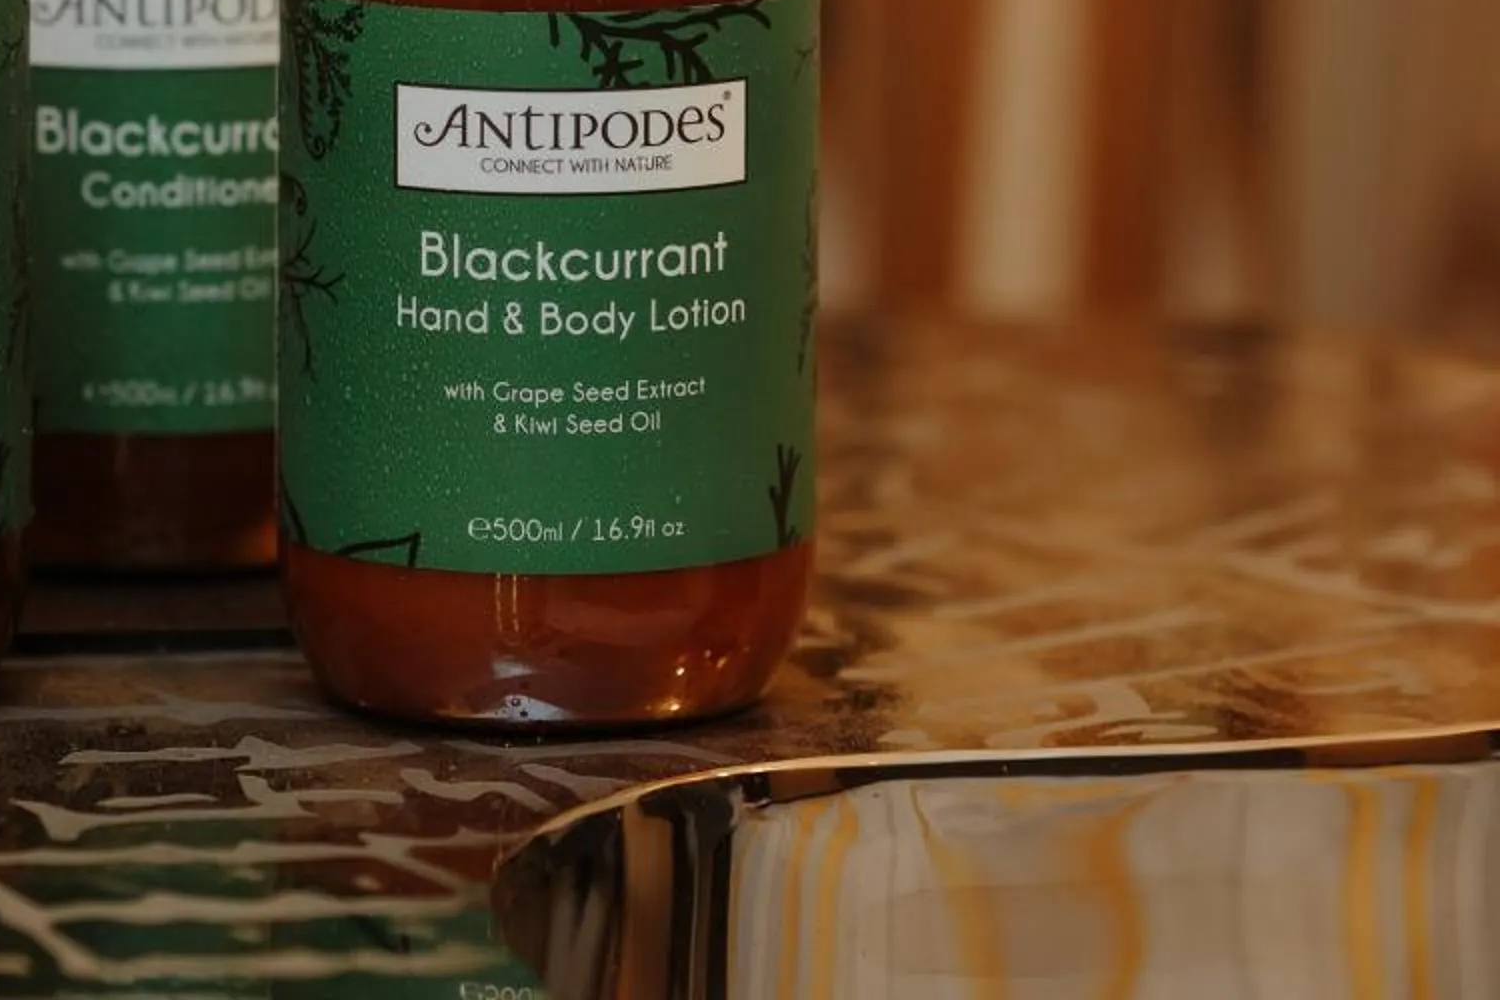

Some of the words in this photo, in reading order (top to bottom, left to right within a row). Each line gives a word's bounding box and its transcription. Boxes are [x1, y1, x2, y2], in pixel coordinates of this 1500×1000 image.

[480, 157, 564, 175] CONNECT
[569, 158, 610, 173] WITH
[614, 154, 673, 172] NATURE
[420, 230, 728, 282] Blackcurrant
[397, 294, 489, 334] Hand
[503, 301, 524, 335] &
[540, 301, 636, 341] Body
[650, 298, 745, 332] Lotion
[443, 380, 485, 401] with
[492, 381, 565, 409] Grape
[572, 380, 629, 403] Seed
[637, 376, 705, 400] Extract
[493, 413, 507, 434] &
[514, 413, 557, 435] Kiwi
[565, 413, 623, 435] Seed
[630, 410, 661, 432] Oil
[571, 519, 583, 541] /
[592, 515, 655, 542] 16.9fl
[661, 521, 685, 537] oz
